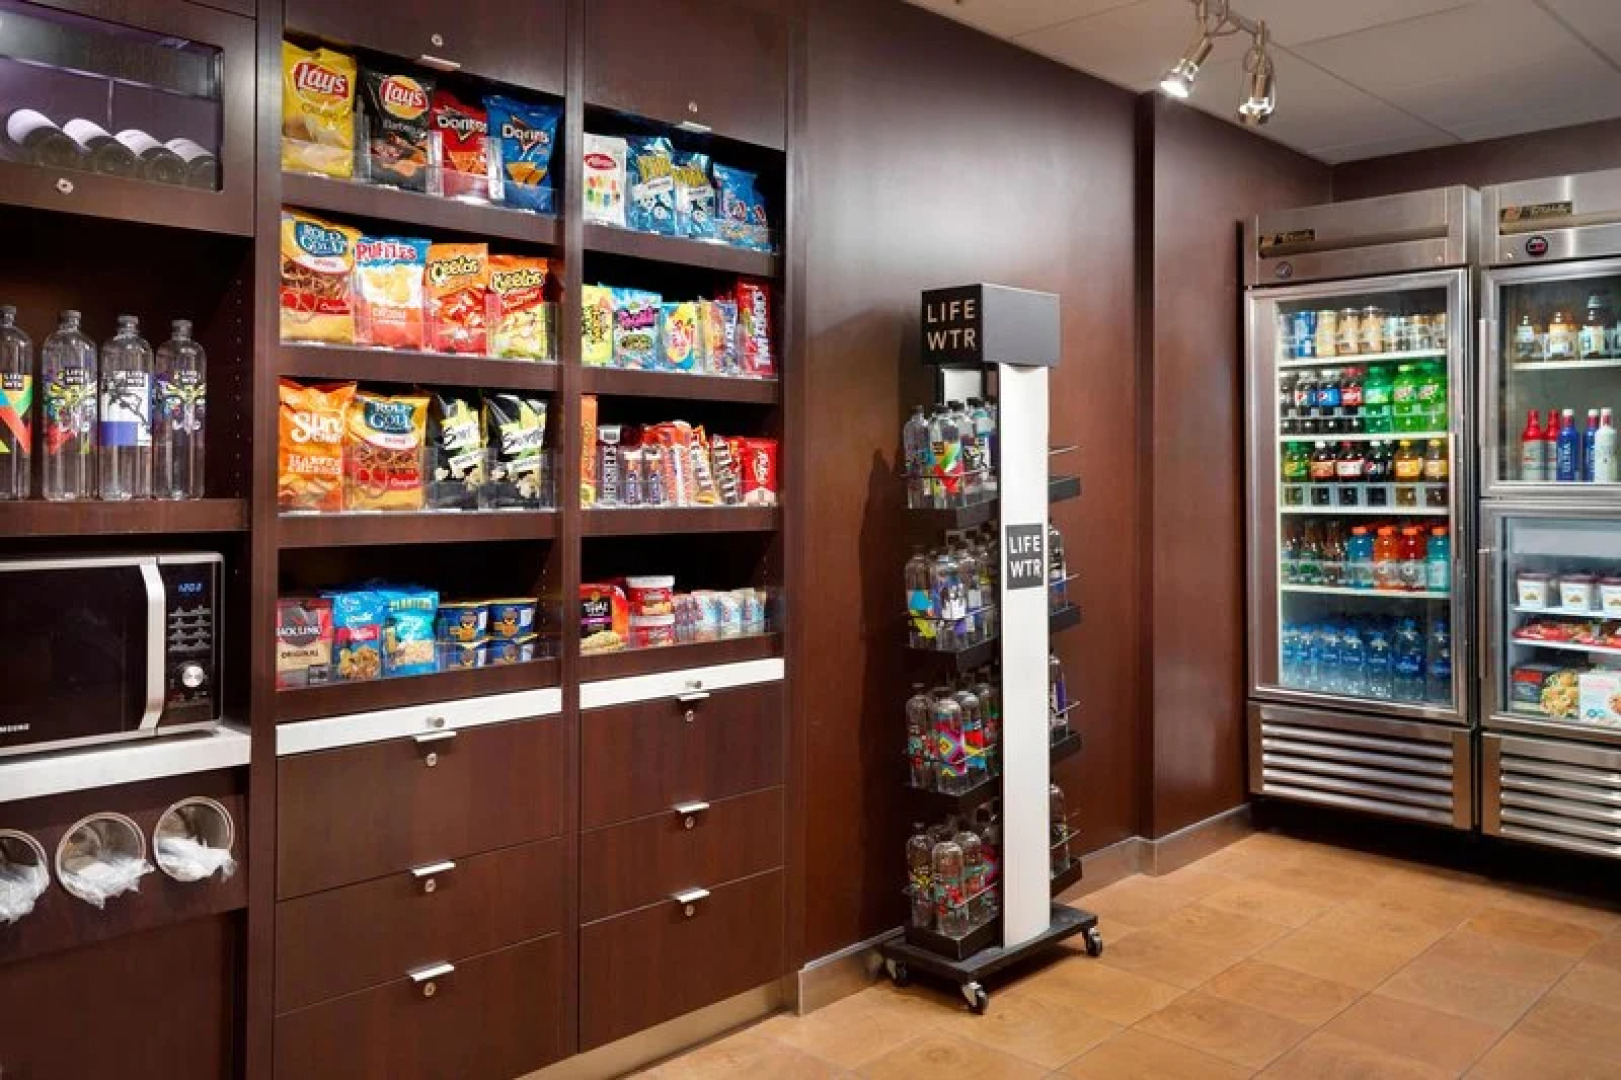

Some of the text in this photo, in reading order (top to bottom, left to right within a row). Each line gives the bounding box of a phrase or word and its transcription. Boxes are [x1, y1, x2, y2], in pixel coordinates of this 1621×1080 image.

[927, 299, 976, 323] LIFE
[927, 327, 977, 352] WTR
[1008, 534, 1041, 554] LIFE
[1009, 559, 1042, 579] WTR
